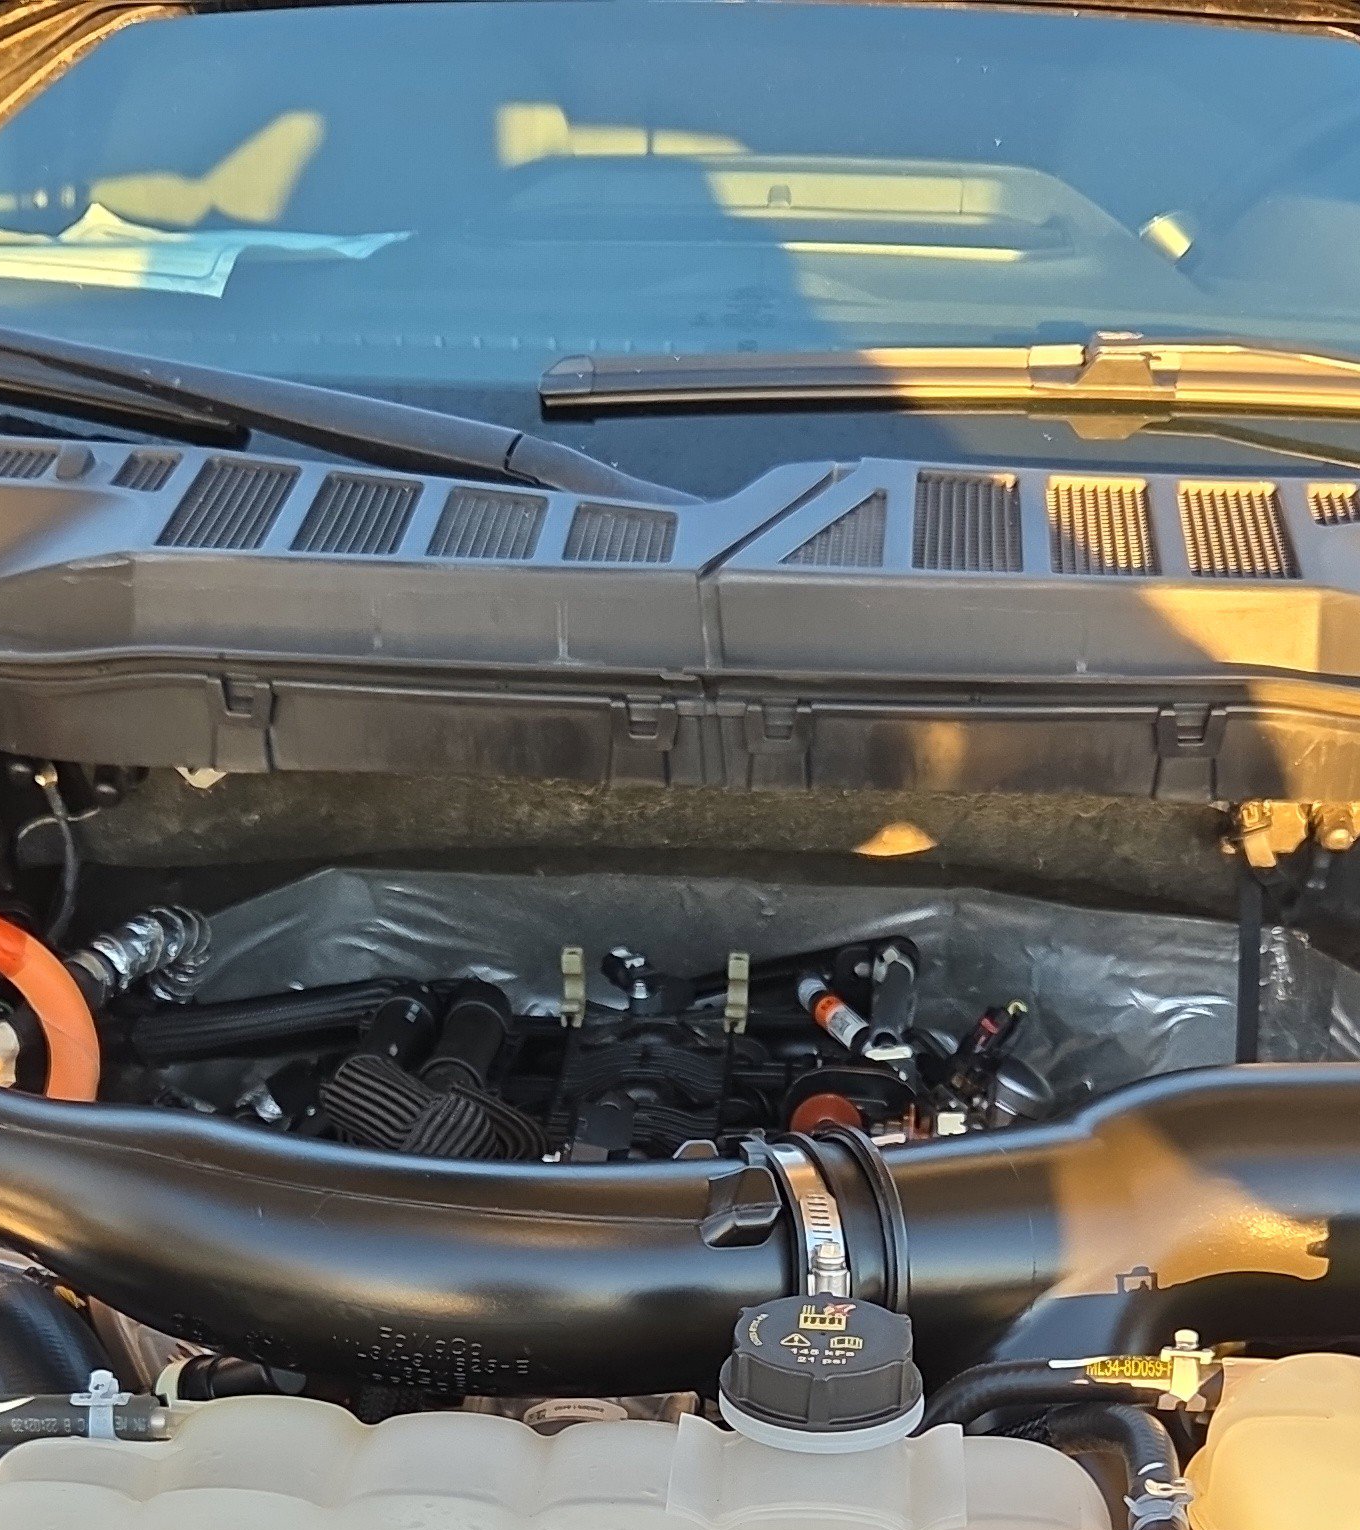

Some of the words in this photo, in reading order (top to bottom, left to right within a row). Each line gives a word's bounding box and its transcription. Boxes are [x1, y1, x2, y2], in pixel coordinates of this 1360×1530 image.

[824, 1349, 855, 1357] kPa
[797, 1356, 816, 1364] 21
[822, 1357, 847, 1365] psi
